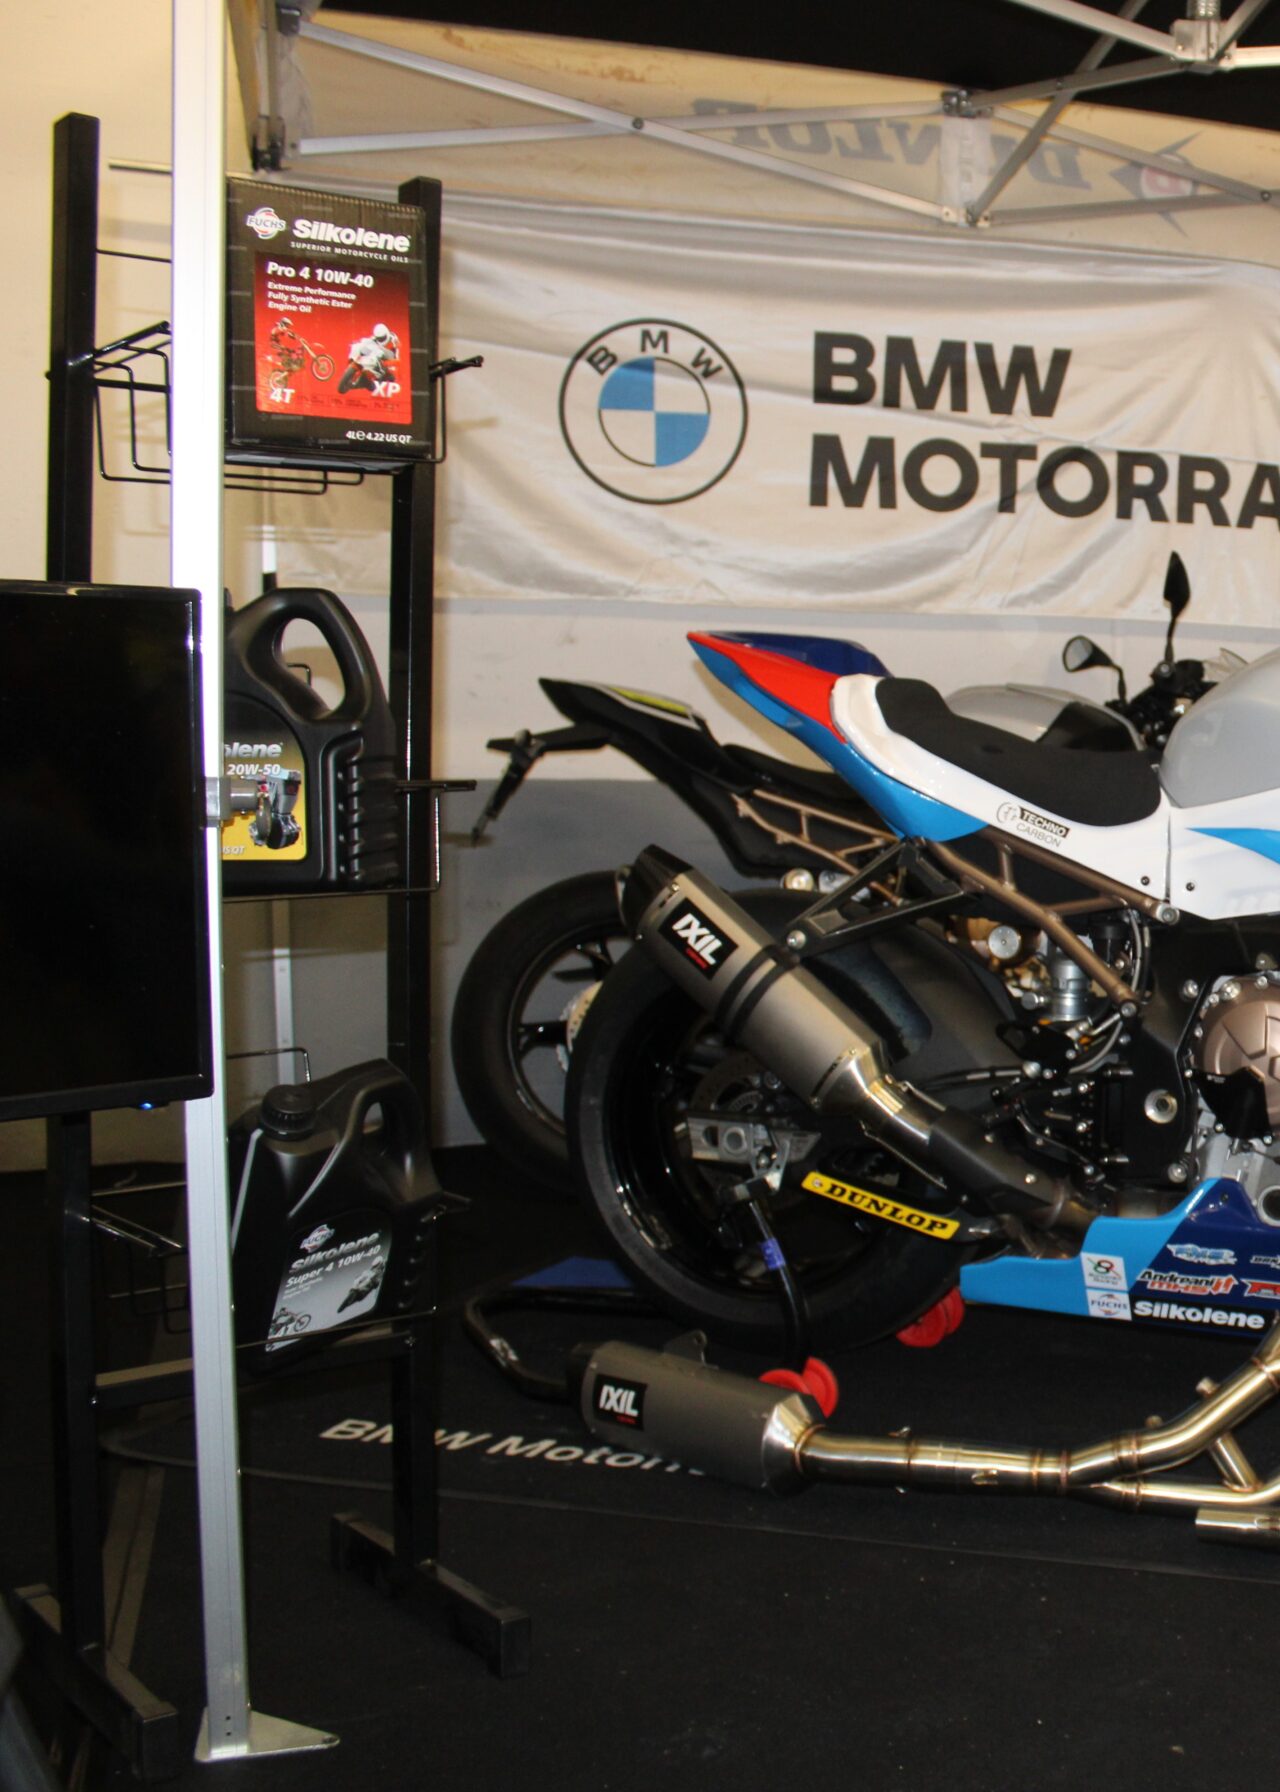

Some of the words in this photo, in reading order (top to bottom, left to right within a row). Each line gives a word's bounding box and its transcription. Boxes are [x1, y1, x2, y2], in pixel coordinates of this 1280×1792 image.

[247, 215, 286, 231] FUCHS
[292, 219, 411, 252] Silkolene
[290, 241, 332, 253] SUPERIOR
[334, 247, 388, 261] MOTORCYCLE
[390, 255, 409, 264] OILS
[266, 261, 296, 278] Pro
[298, 266, 311, 280] 4
[315, 268, 374, 288] 10W-40
[267, 281, 303, 293] Extreme
[304, 286, 357, 301] Performance
[268, 291, 289, 303] Fully
[290, 293, 330, 307] Synthetic
[331, 298, 353, 310] Ester
[268, 301, 297, 314] Engine
[299, 305, 312, 314] Oil
[586, 329, 722, 379] BMW
[812, 331, 1072, 418] BMW
[270, 388, 295, 404] 4T
[372, 380, 400, 398] XP
[227, 764, 280, 776] 20W-50
[1017, 823, 1061, 847] CARBON
[1022, 811, 1067, 837] TECHNO
[672, 913, 722, 965] IXIL
[825, 1183, 948, 1232] DUNLOP
[289, 1232, 379, 1273] Silkolene
[286, 1267, 323, 1288] Super
[325, 1262, 334, 1272] 4
[338, 1245, 381, 1268] 10W-40
[1134, 1301, 1265, 1329] Silkolene
[599, 1384, 639, 1417] IXIL
